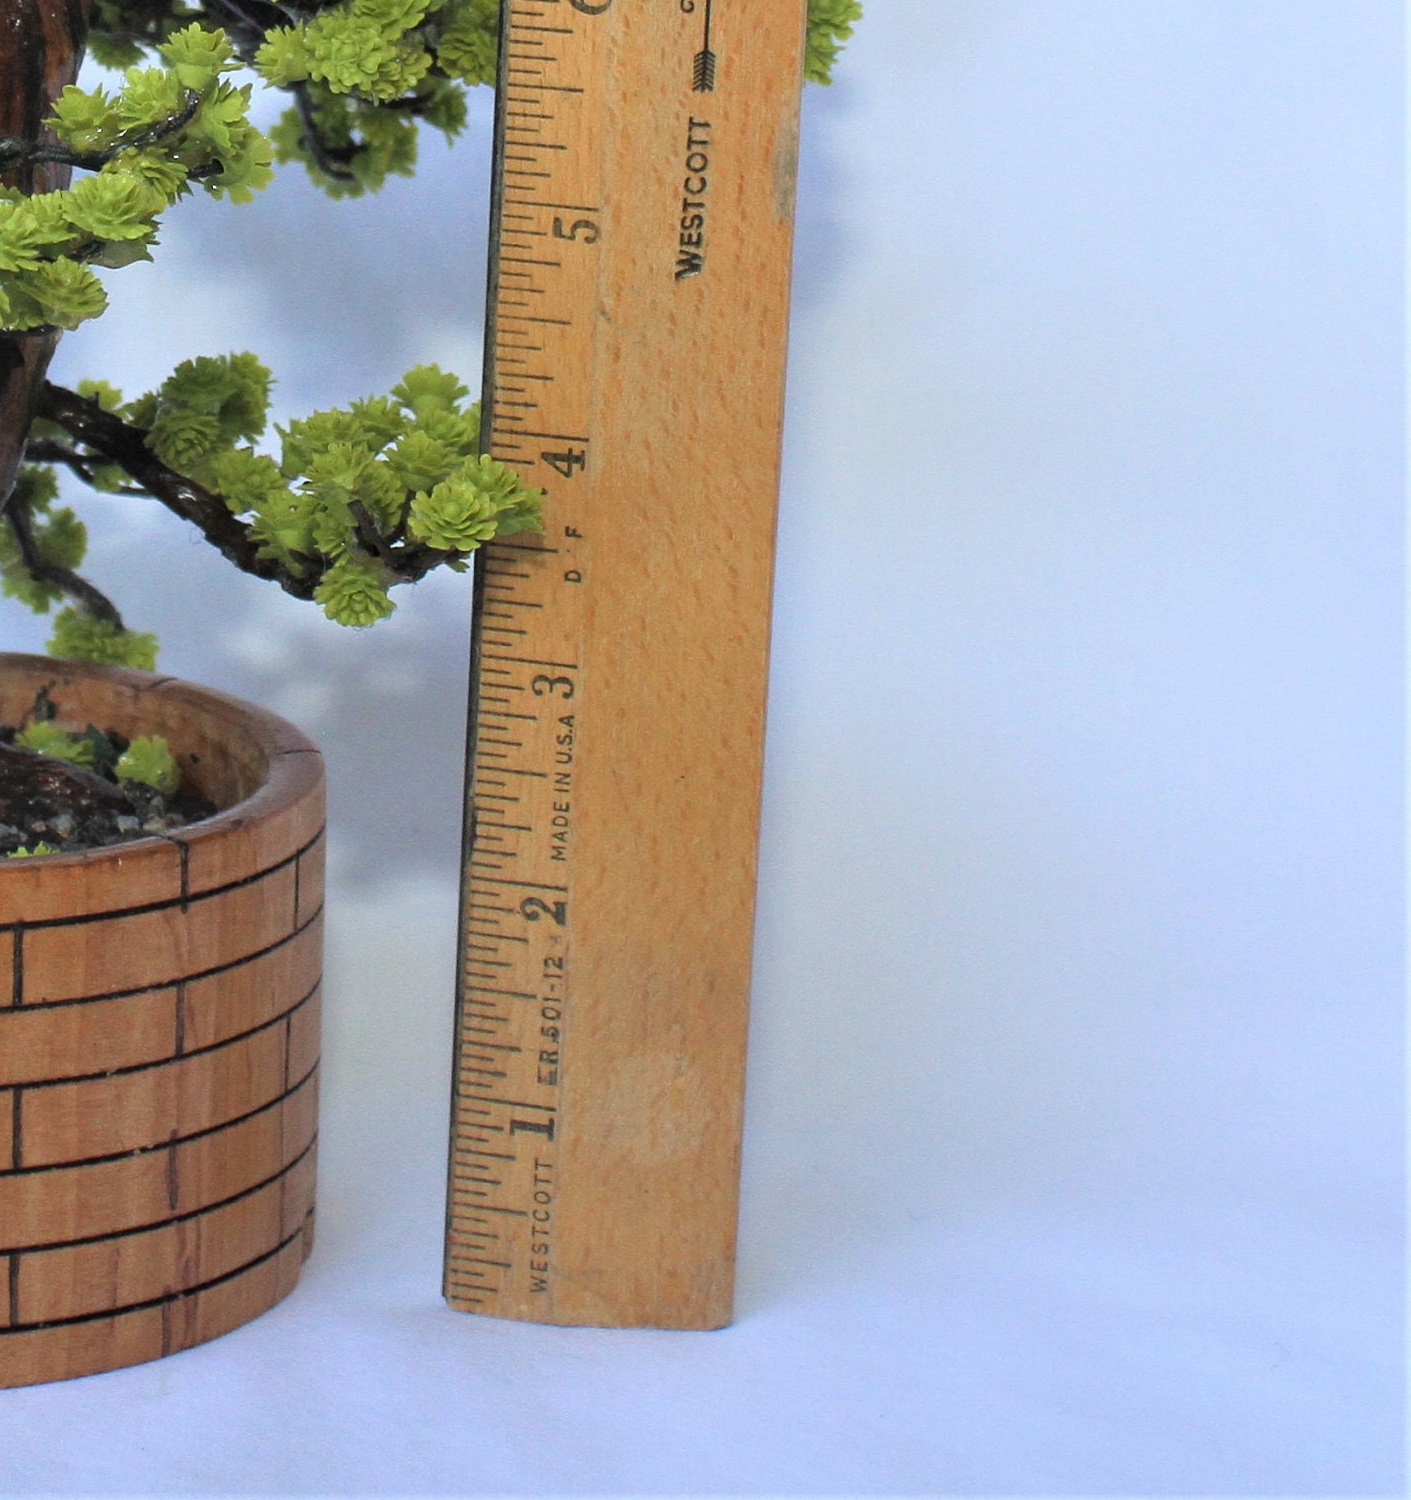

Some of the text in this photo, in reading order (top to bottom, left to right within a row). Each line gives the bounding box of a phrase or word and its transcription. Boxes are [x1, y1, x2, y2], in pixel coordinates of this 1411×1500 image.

[674, 116, 712, 282] WESTCOTT
[551, 215, 602, 246] 5
[540, 447, 586, 479] 4
[531, 674, 575, 700] 3
[554, 771, 573, 793] IN
[550, 801, 571, 862] MADE
[519, 896, 568, 927] 2
[508, 1116, 555, 1142] 1
[529, 1157, 554, 1295] WESTCOTT
